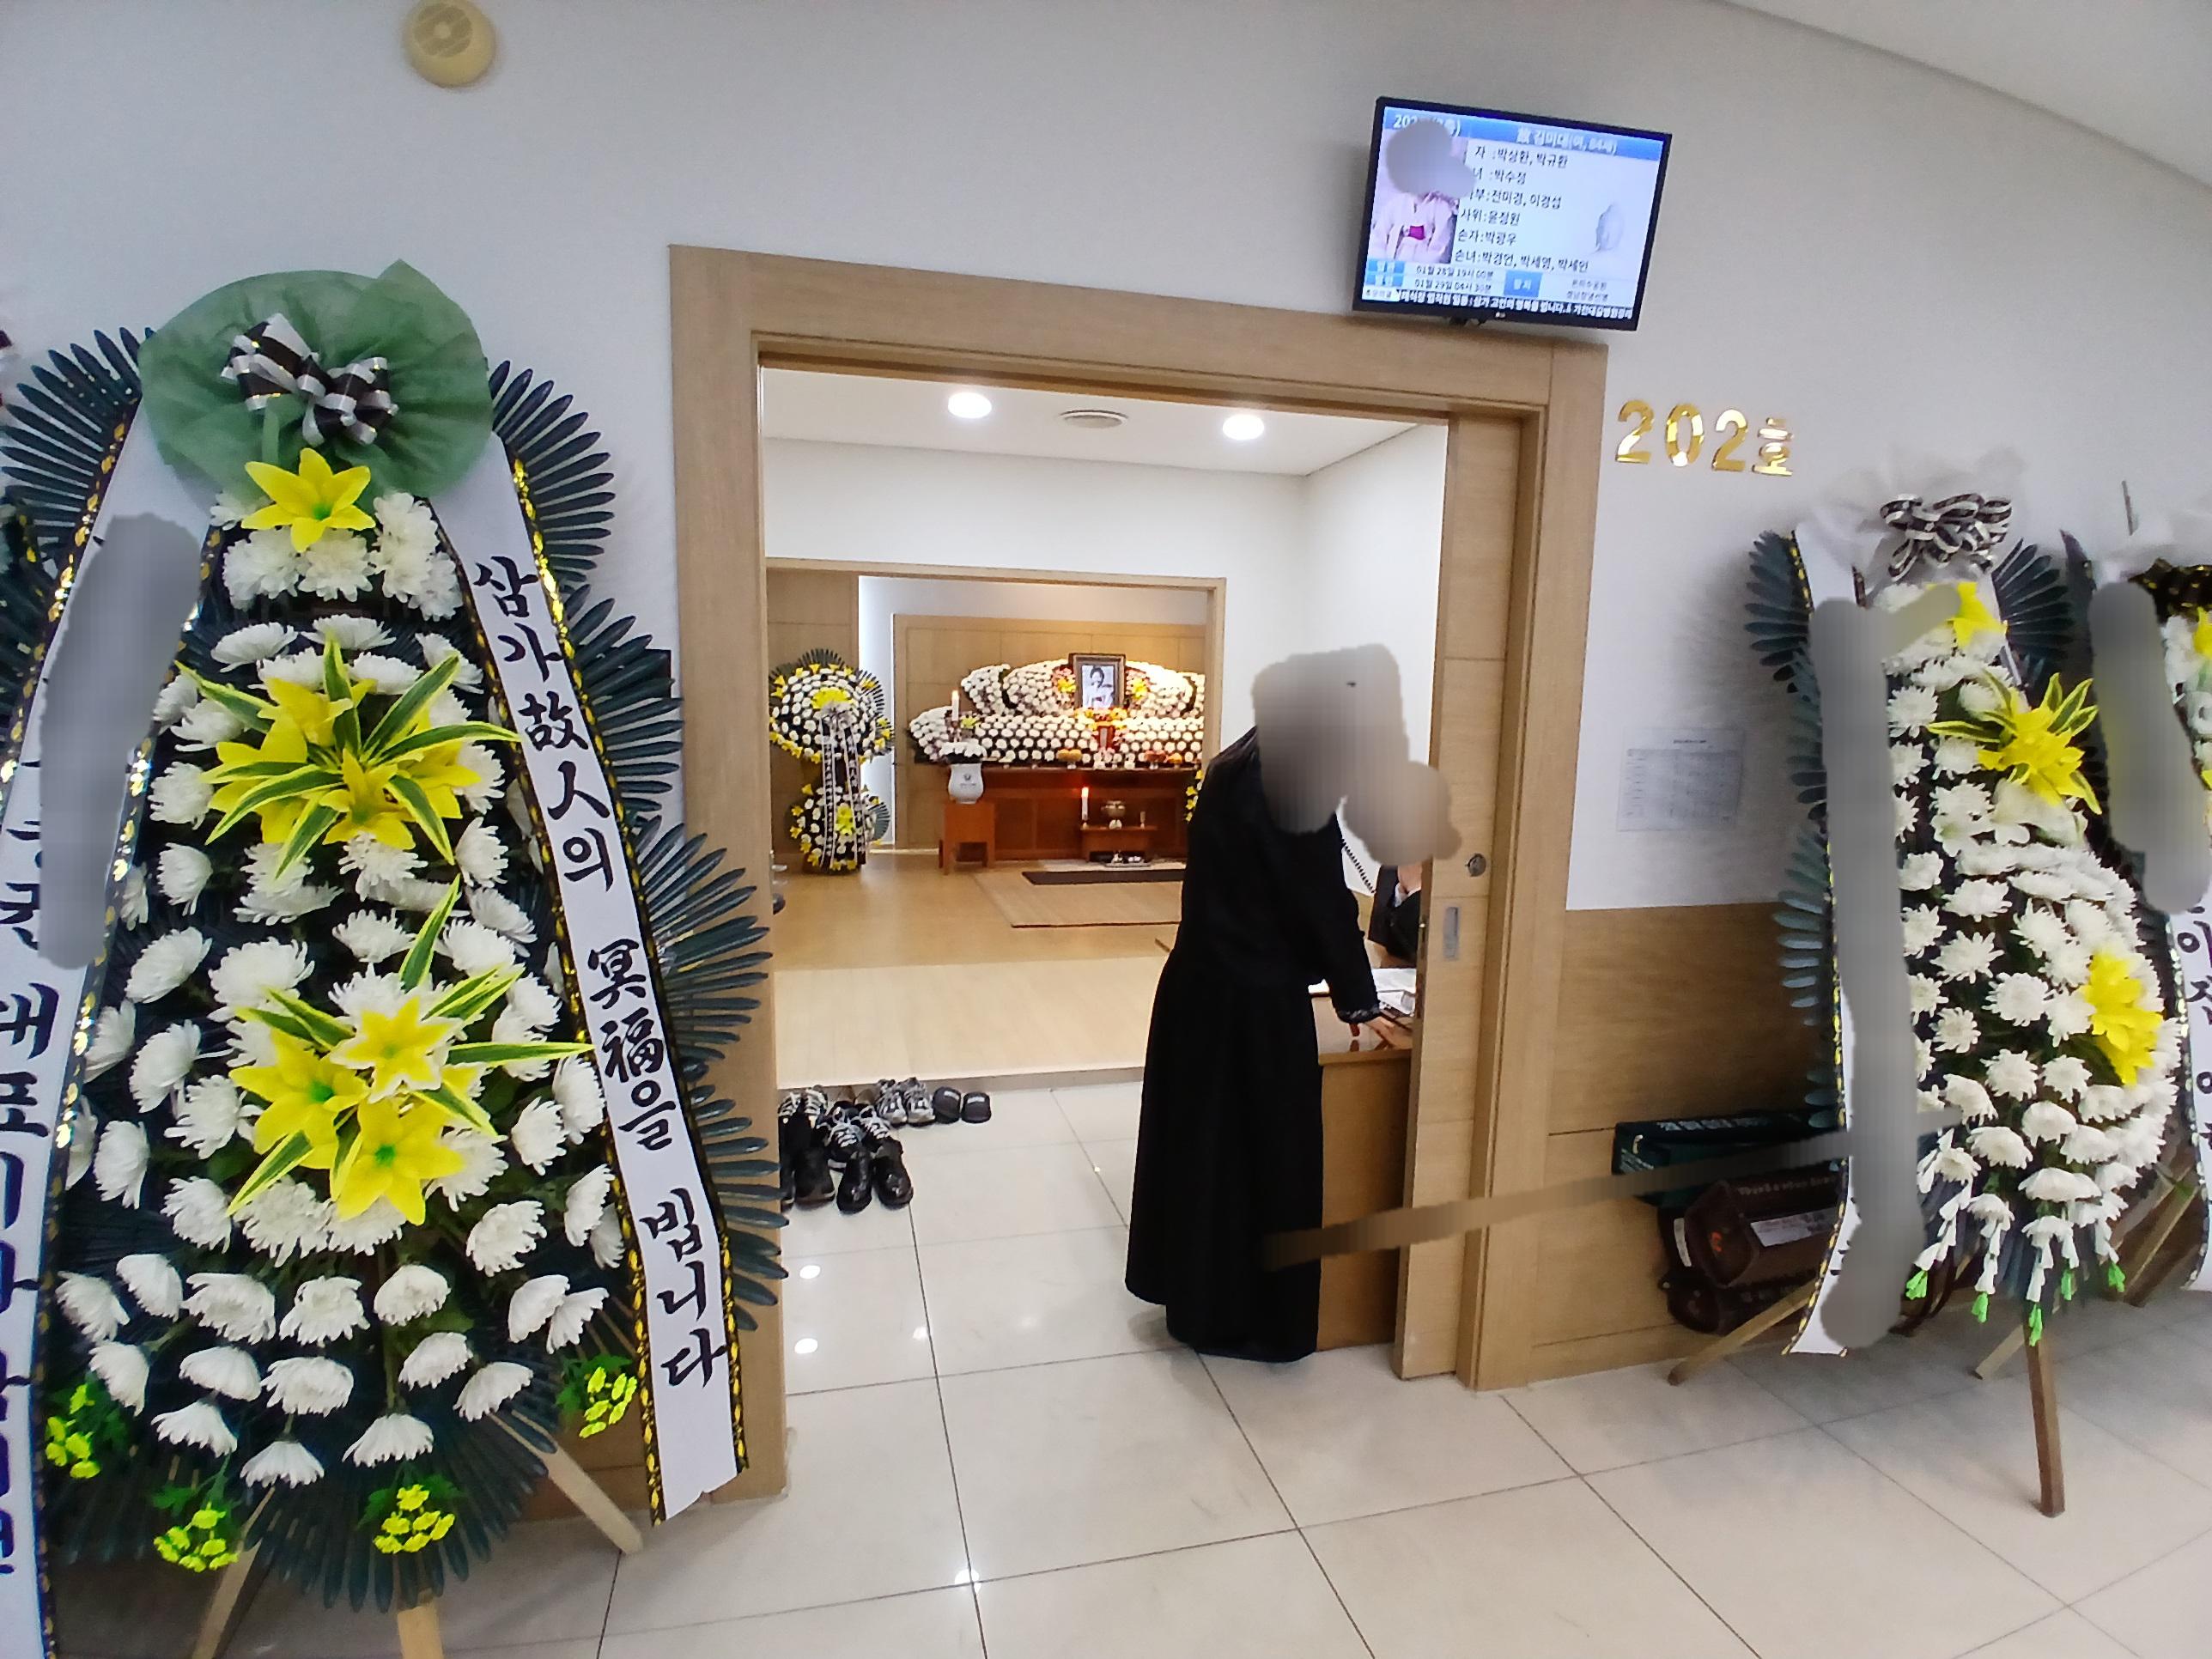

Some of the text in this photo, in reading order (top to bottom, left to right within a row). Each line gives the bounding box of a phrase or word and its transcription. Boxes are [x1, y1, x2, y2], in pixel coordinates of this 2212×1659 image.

[1615, 399, 1794, 477] 202호
[473, 556, 727, 1389] 삼가 故人의 冥福을 빕니다
